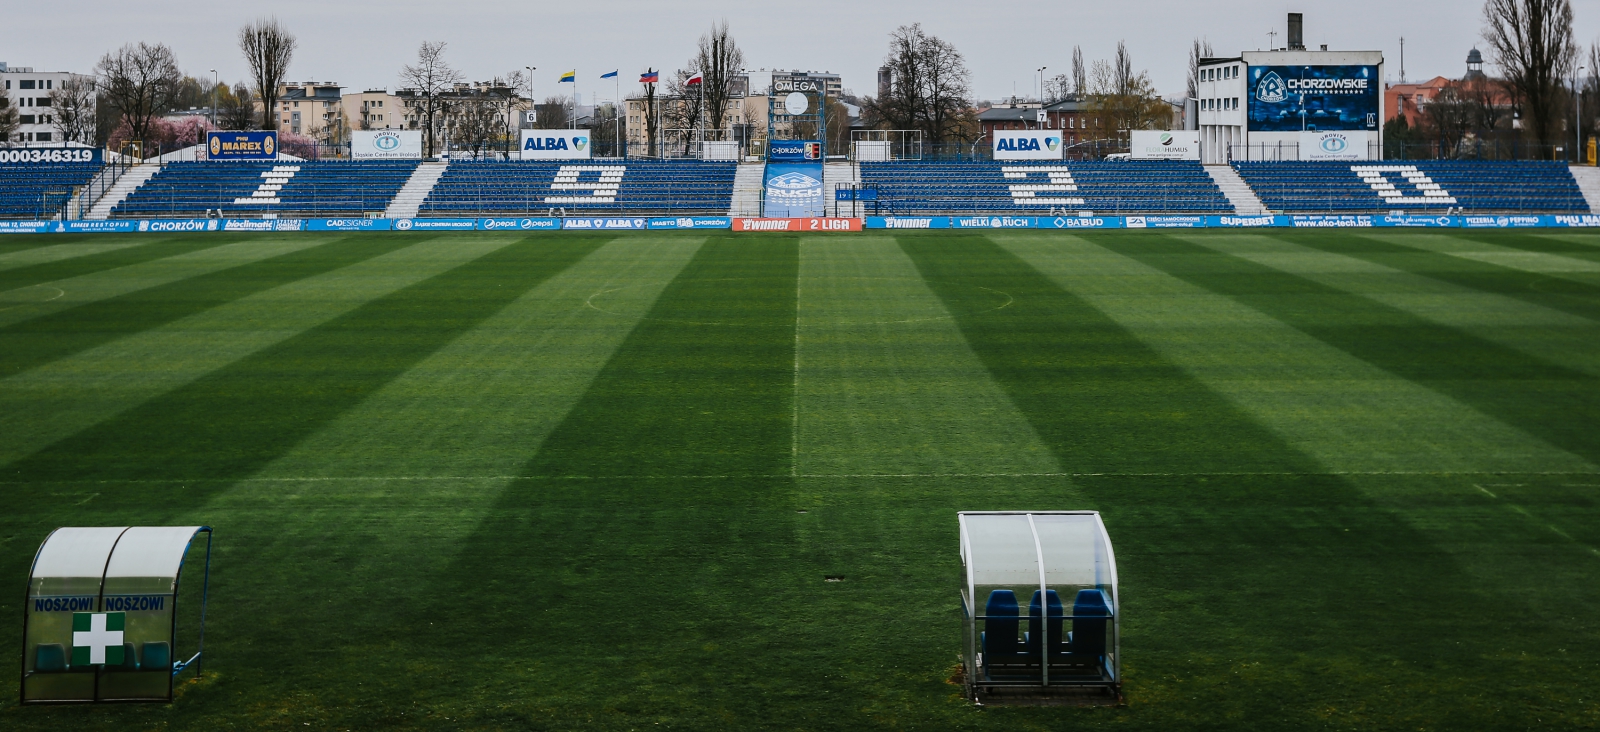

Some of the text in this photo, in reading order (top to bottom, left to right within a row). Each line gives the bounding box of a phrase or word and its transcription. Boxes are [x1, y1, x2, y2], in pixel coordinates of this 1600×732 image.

[775, 81, 817, 91] OMEGA
[1288, 79, 1368, 89] CHORZOWSKIE
[222, 142, 261, 150] MAREX
[524, 138, 568, 150] ALBA
[996, 138, 1040, 151] ALBA
[772, 146, 803, 154] CHORZÓW
[0, 150, 92, 162] 000346319
[767, 188, 821, 196] RUCH
[151, 219, 205, 231] CHORZÓW
[225, 219, 273, 228] bioclimatic
[565, 219, 632, 228] ALBA ALBA
[742, 219, 849, 230] ewinner 2 LIGA
[884, 217, 932, 228] ewinner
[1220, 216, 1274, 226] SUPERBET
[1555, 216, 1579, 224] PHU
[35, 598, 93, 612] NOSZOWI
[105, 597, 164, 611] NOSZOWI
